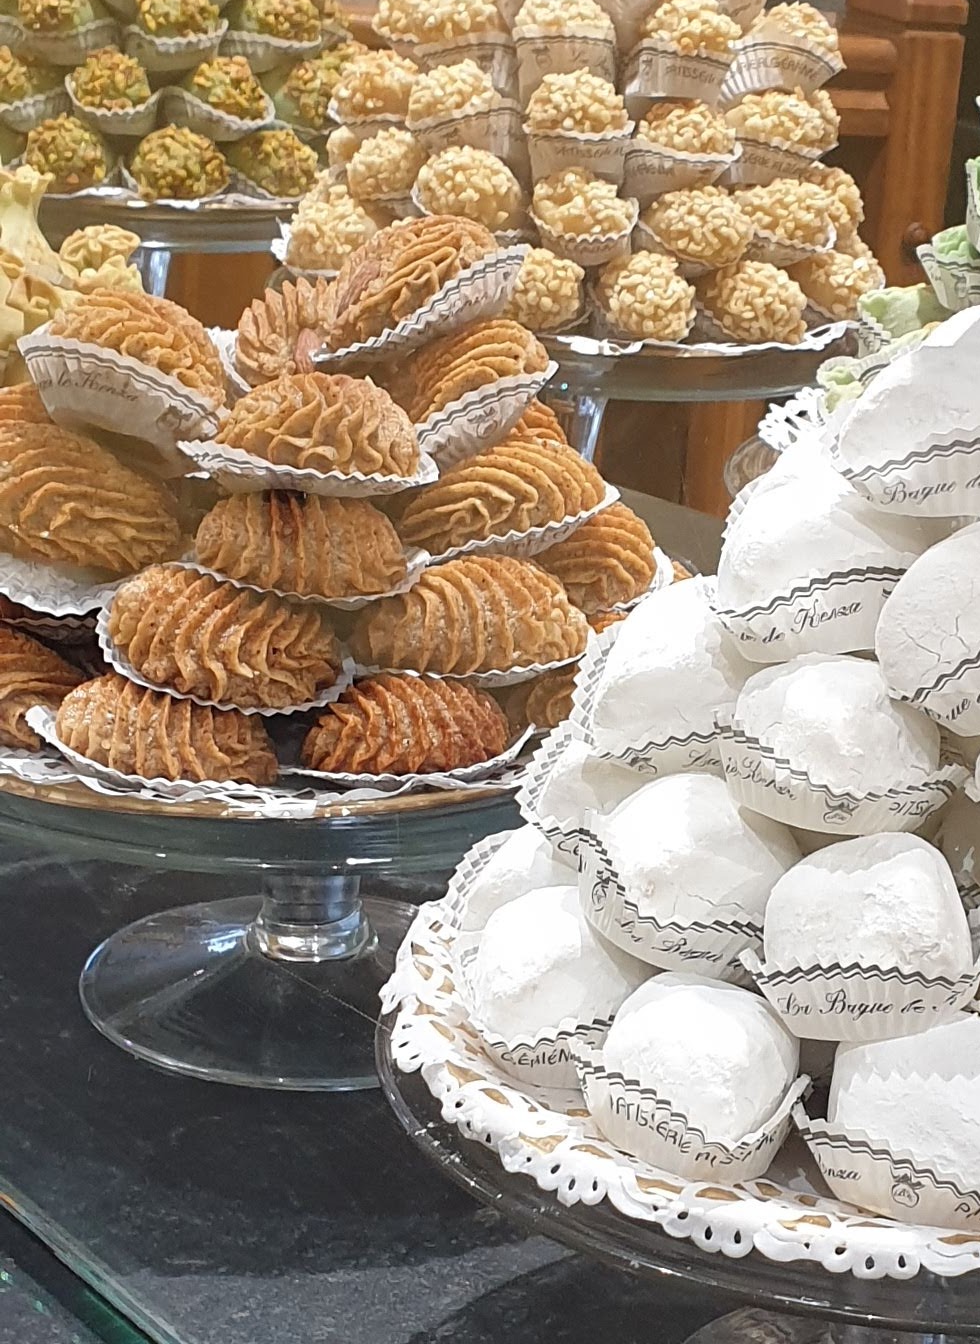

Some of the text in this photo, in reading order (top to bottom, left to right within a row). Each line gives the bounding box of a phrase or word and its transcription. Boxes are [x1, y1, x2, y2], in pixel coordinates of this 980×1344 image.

[880, 479, 957, 506] Bague
[790, 598, 863, 634] Kenza
[819, 987, 895, 1022] Bague
